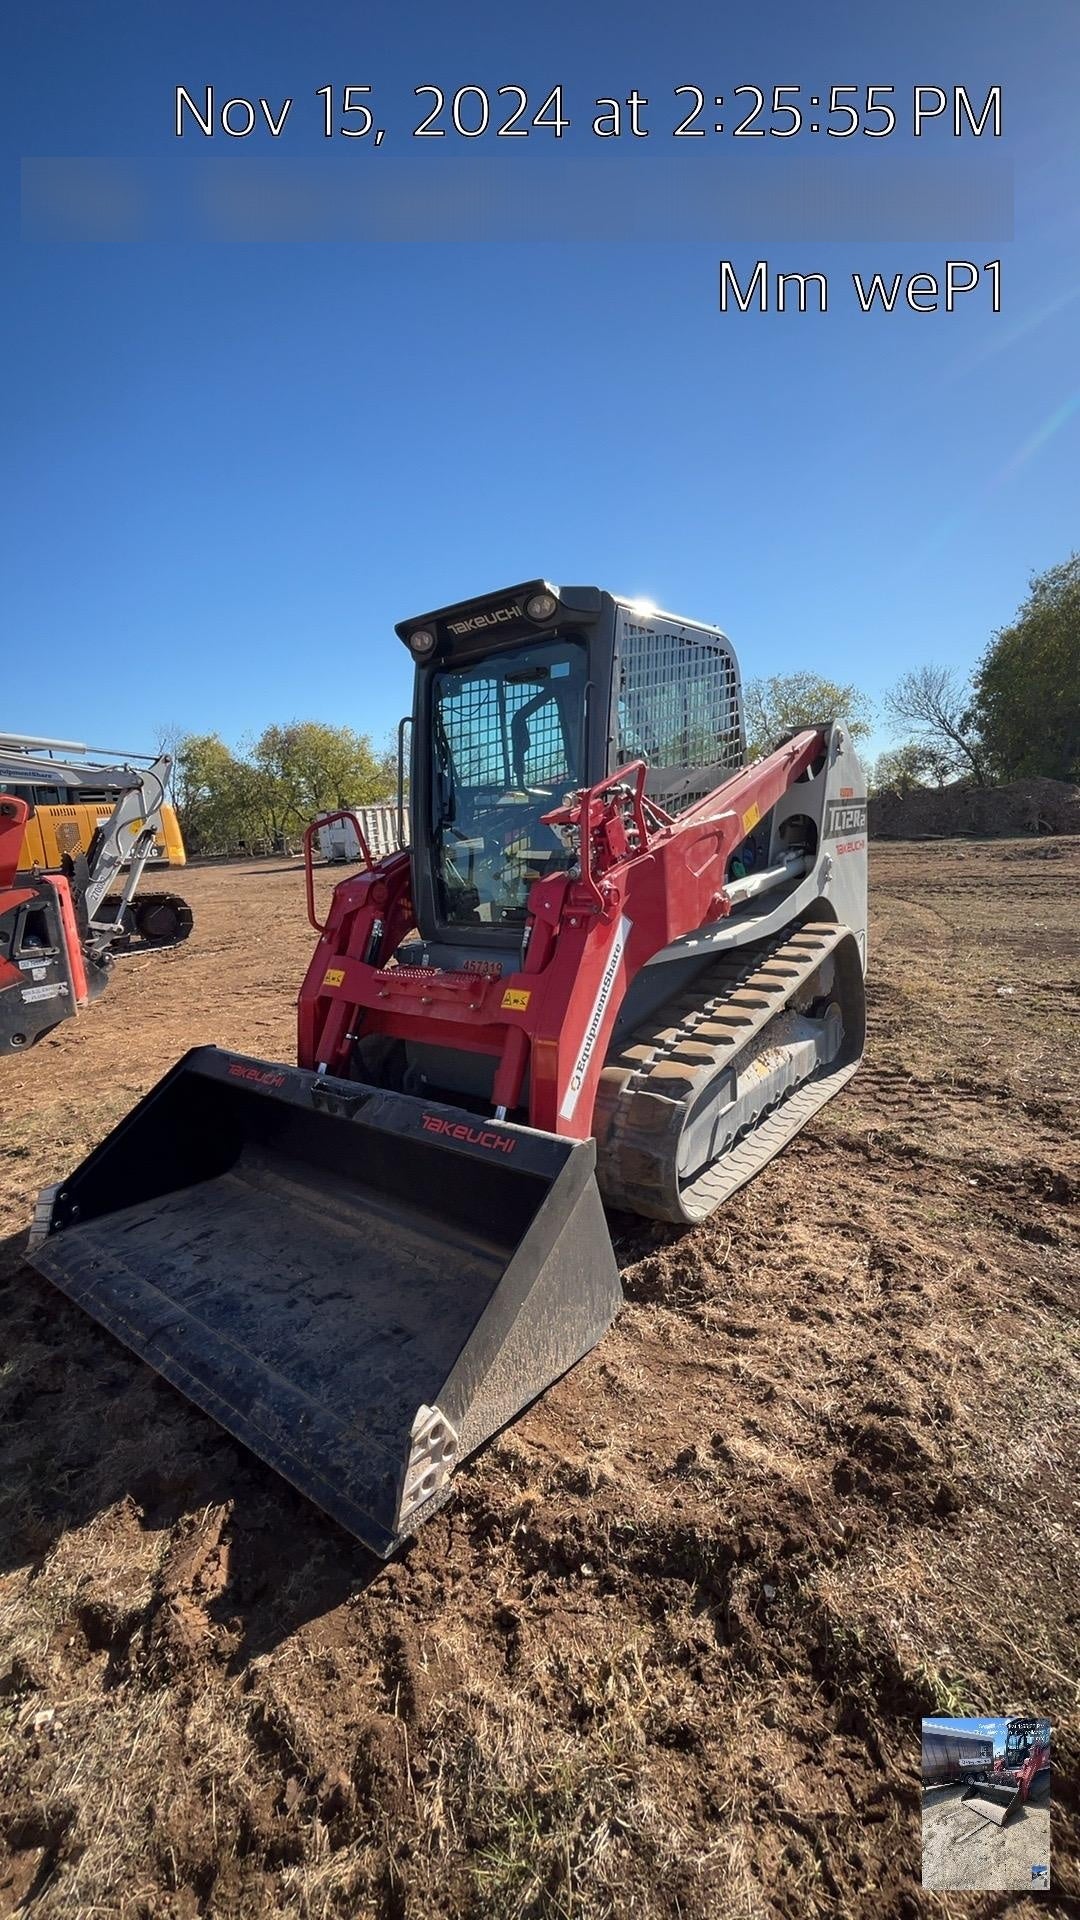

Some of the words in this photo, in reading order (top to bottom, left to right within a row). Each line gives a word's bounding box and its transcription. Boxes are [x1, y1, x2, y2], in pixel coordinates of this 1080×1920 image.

[447, 605, 522, 635] TAKEUCHI
[576, 943, 622, 1074] EquipmentShare
[229, 1063, 286, 1088] TAKEUCHI
[422, 1115, 515, 1153] TAKEUCHI
